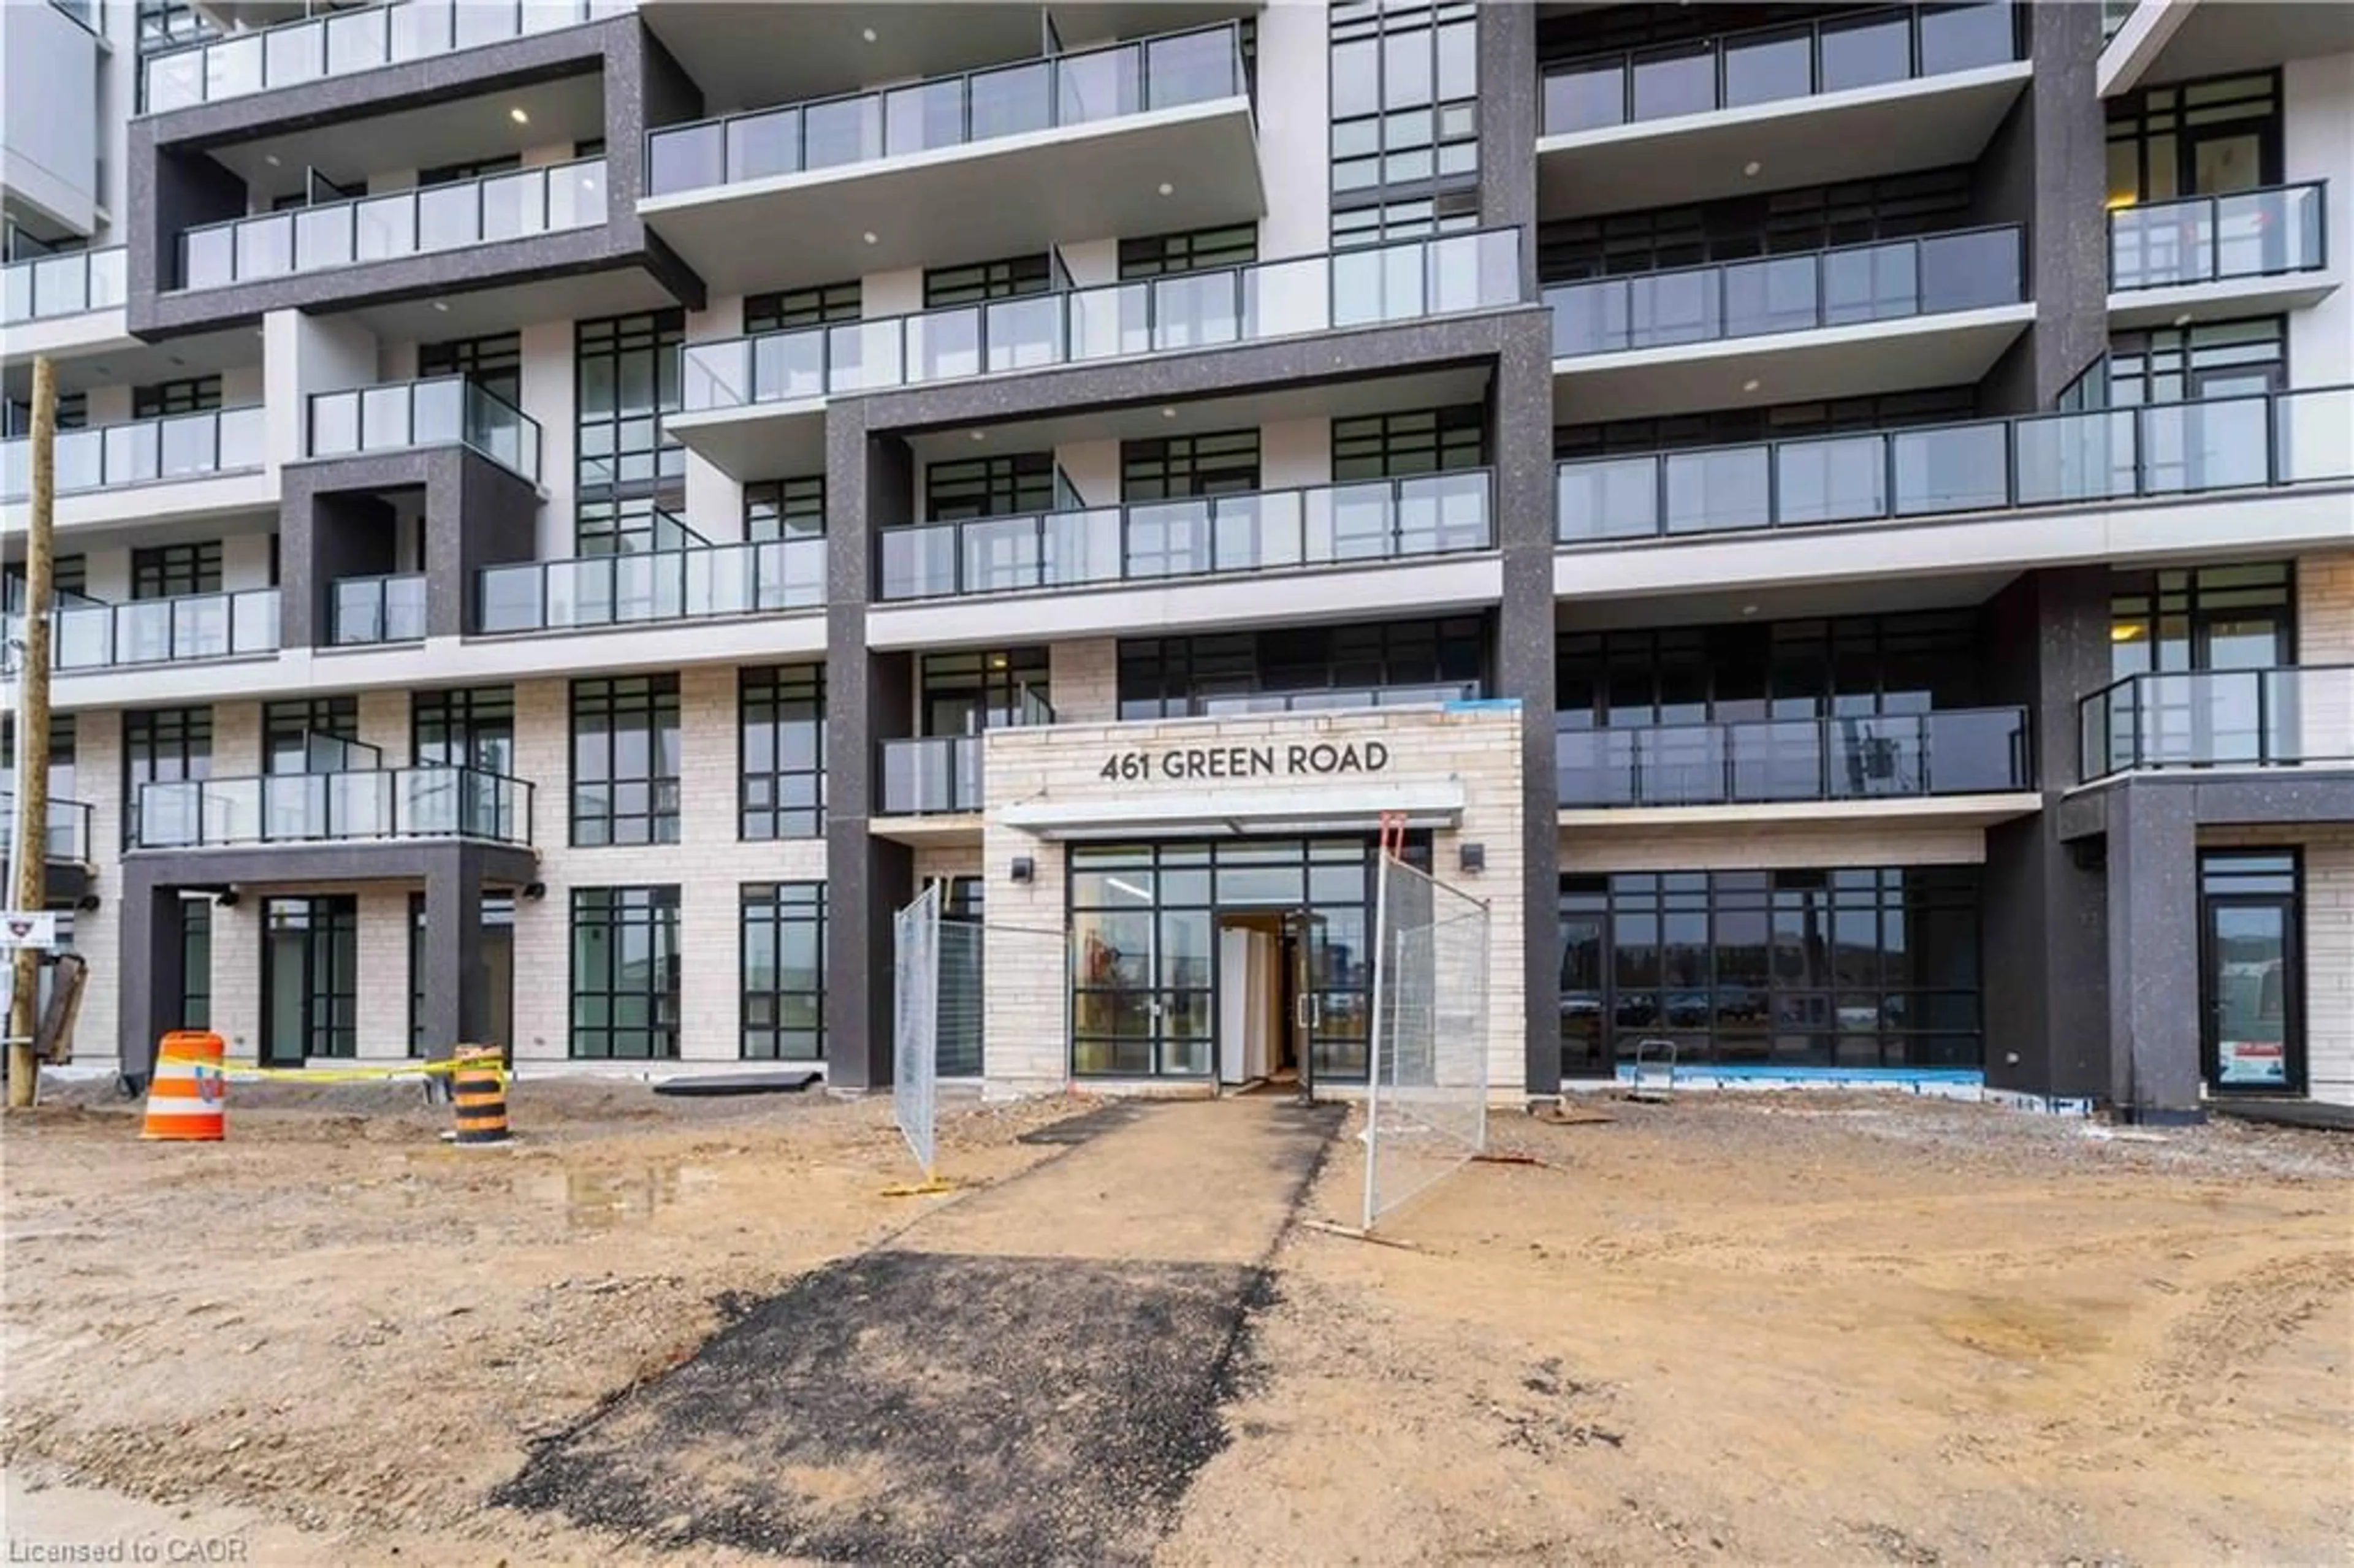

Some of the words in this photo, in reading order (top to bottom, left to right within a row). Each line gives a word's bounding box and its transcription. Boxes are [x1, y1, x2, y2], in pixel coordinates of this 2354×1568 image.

[1100, 752, 1149, 781] 461
[1162, 746, 1274, 778] GREEN
[1289, 742, 1388, 774] ROAD
